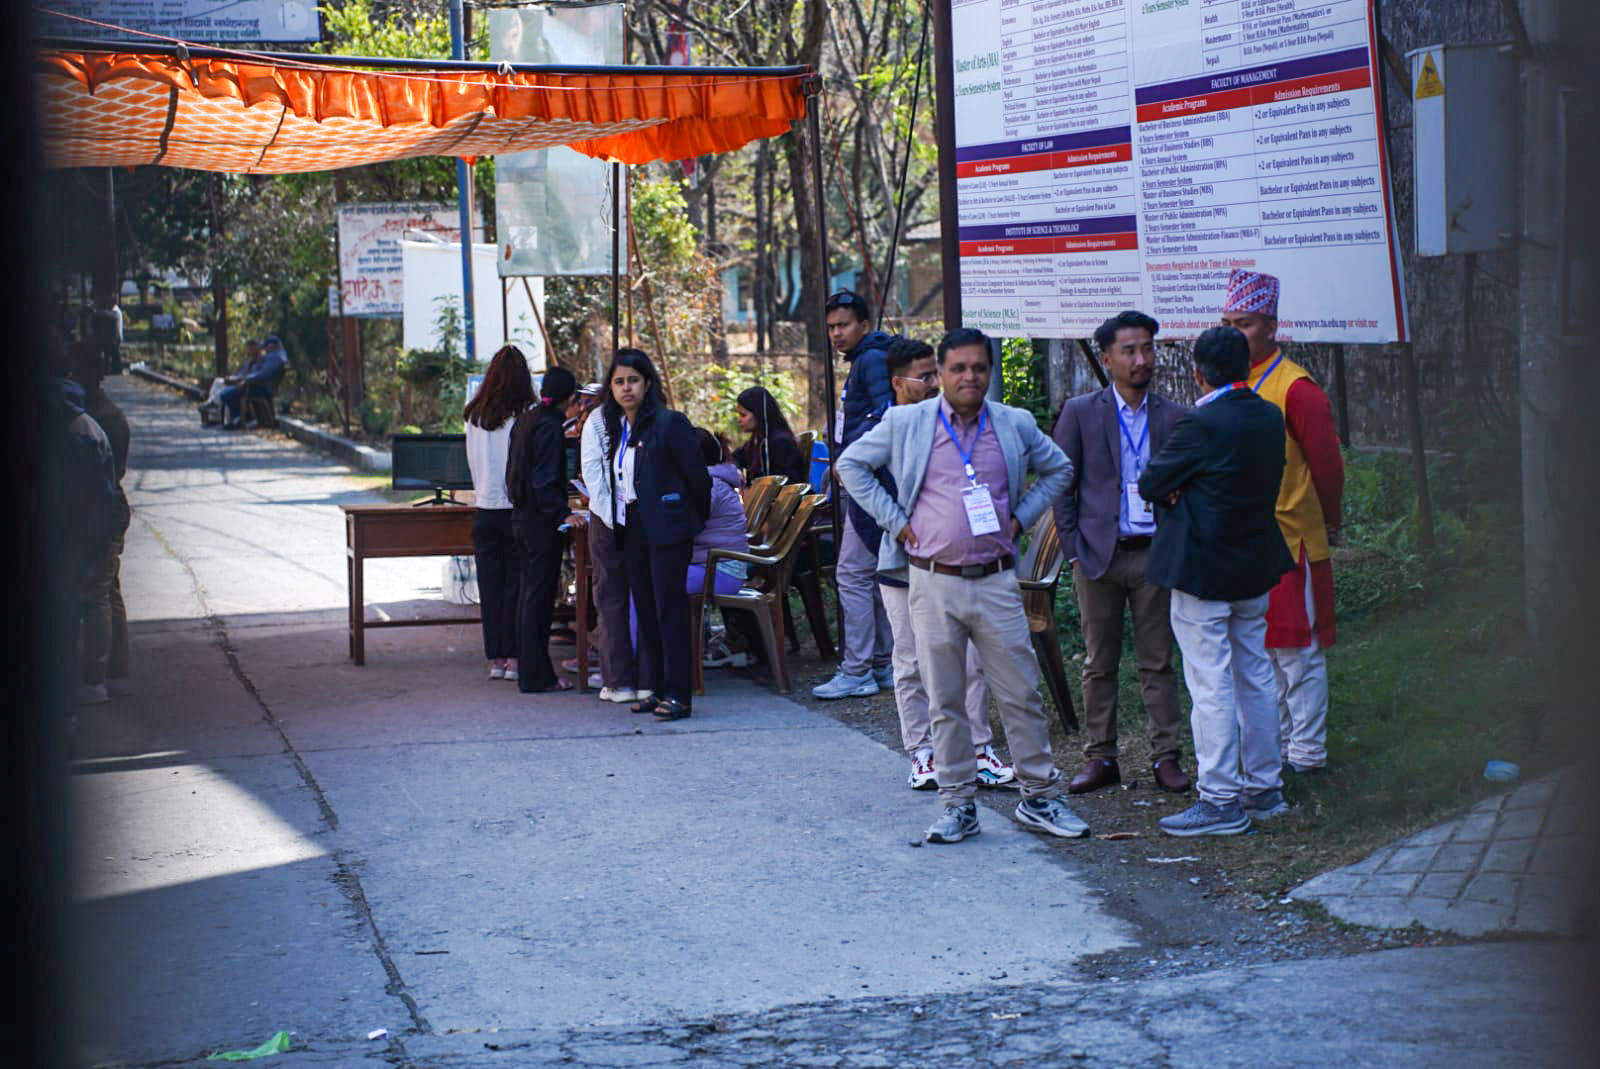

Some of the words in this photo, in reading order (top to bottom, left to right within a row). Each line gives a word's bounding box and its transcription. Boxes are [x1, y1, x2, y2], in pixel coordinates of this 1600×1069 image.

[1211, 76, 1232, 88] FACULTY
[1233, 75, 1239, 86] OF
[1240, 69, 1277, 85] MANAGEMENT
[1274, 89, 1300, 100] Admission
[1302, 82, 1340, 98] Requirements
[1162, 101, 1183, 112] Academic
[1184, 99, 1207, 111] Programs
[1268, 105, 1296, 119] Equivalent
[1296, 103, 1309, 113] Pass
[1310, 102, 1316, 111] in
[1316, 102, 1326, 112] any
[1326, 97, 1350, 111] subjects
[1256, 135, 1263, 144] +2
[1270, 131, 1298, 144] Equivalent
[1298, 129, 1311, 139] Pass
[1312, 128, 1318, 137] in
[1318, 129, 1328, 138] any
[1328, 124, 1353, 137] subjects
[1258, 161, 1265, 170] +2
[1272, 157, 1300, 170] Equivalent
[1300, 156, 1313, 165] Pass
[1314, 155, 1320, 164] in
[1320, 155, 1330, 165] any
[1330, 151, 1354, 164] subjects
[1260, 185, 1282, 195] Bachelor
[1290, 181, 1319, 194] Equivalent
[1319, 180, 1332, 190] Pass
[1332, 180, 1339, 188] in
[1340, 180, 1350, 190] any
[1350, 176, 1376, 189] subjects
[1262, 210, 1285, 220] Bachelor
[1292, 207, 1321, 220] Equivalent
[1321, 206, 1334, 216] Pass
[1335, 206, 1340, 215] in
[1342, 207, 1352, 216] any
[1352, 203, 1378, 216] subjects
[1264, 236, 1287, 245] Bachelor
[1294, 234, 1323, 245] Equivalent
[1323, 233, 1336, 242] Pass
[1336, 232, 1342, 241] in
[1343, 234, 1354, 243] any
[1355, 230, 1380, 242] subjects
